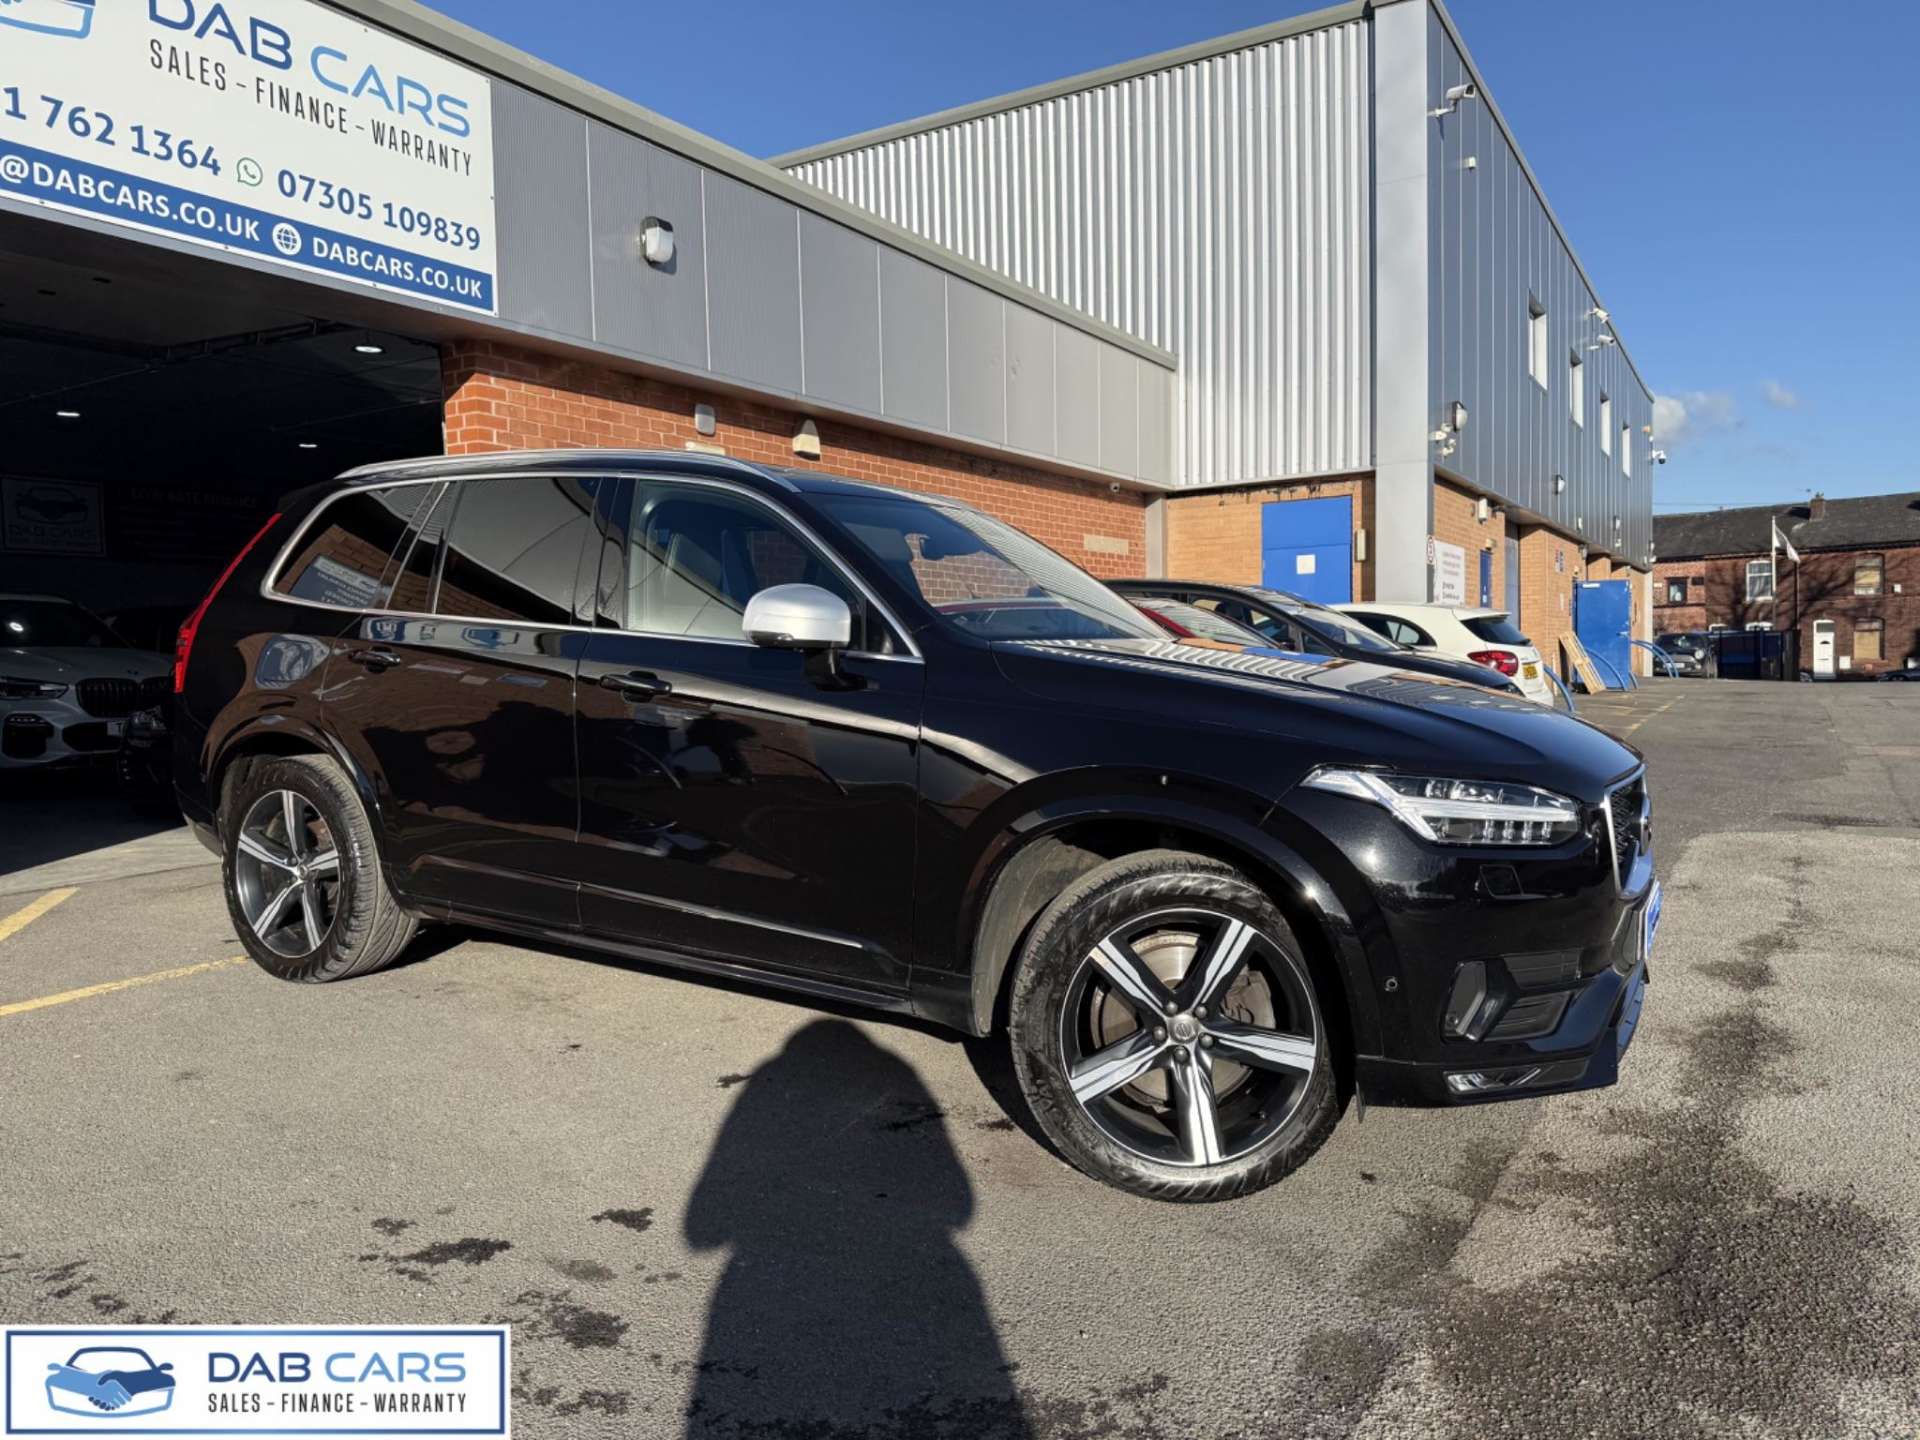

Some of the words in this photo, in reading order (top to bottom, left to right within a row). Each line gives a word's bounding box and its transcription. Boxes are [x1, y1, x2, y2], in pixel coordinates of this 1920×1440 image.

[149, 39, 226, 91] SALES
[255, 76, 348, 134] FINANCE
[371, 118, 472, 176] WARRANTY
[310, 45, 471, 138] CARS
[40, 95, 116, 146] 762
[130, 125, 221, 176] 1364
[0, 154, 261, 242] @DABCARS.CO.UK
[277, 169, 373, 220] 07305
[382, 202, 481, 251] 109839
[312, 236, 482, 299] DABCARS.CO.UK
